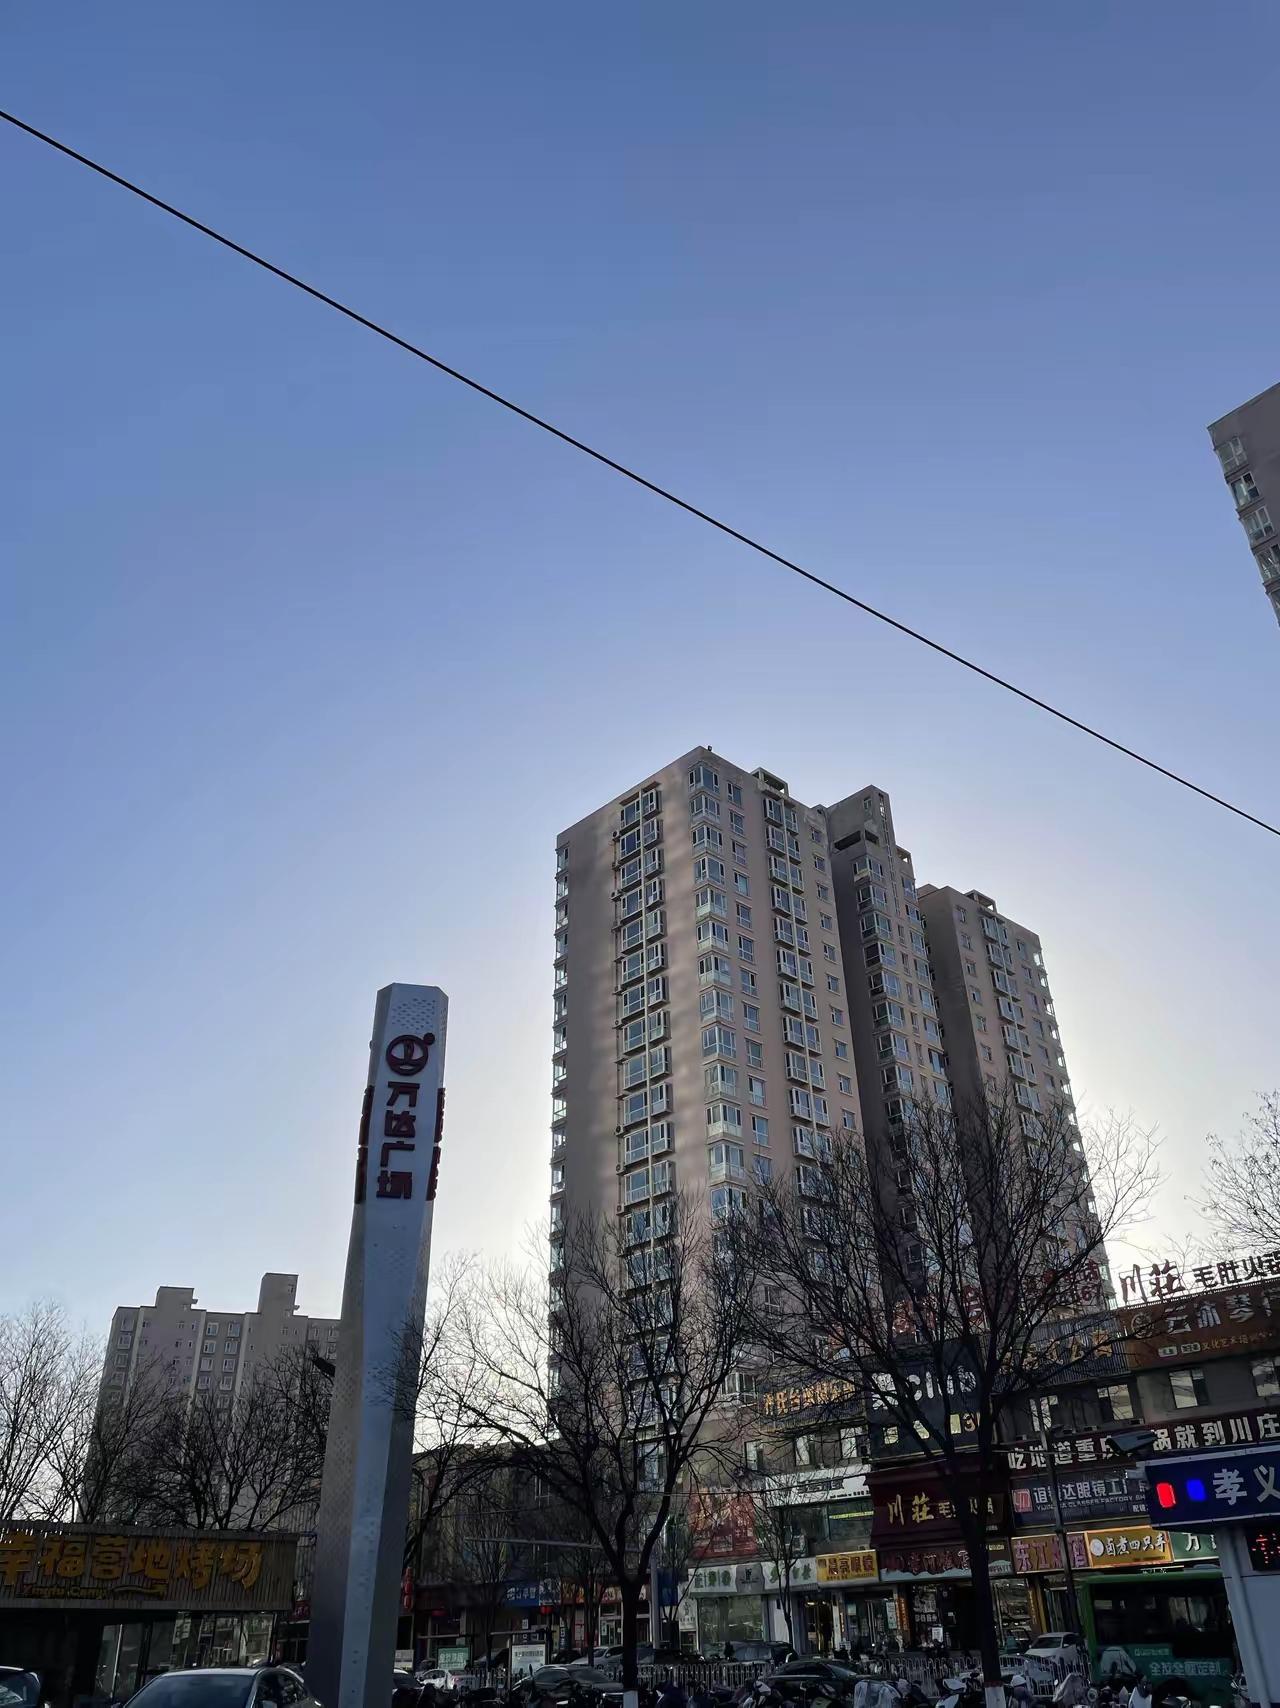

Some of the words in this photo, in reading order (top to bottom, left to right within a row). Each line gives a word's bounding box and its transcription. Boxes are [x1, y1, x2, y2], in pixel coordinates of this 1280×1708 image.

[1007, 1413, 1280, 1470] 吃地道重庆锅就到川庄
[1032, 1477, 1128, 1505] 谊达眼镜工厂
[1213, 1464, 1280, 1506] 孝义
